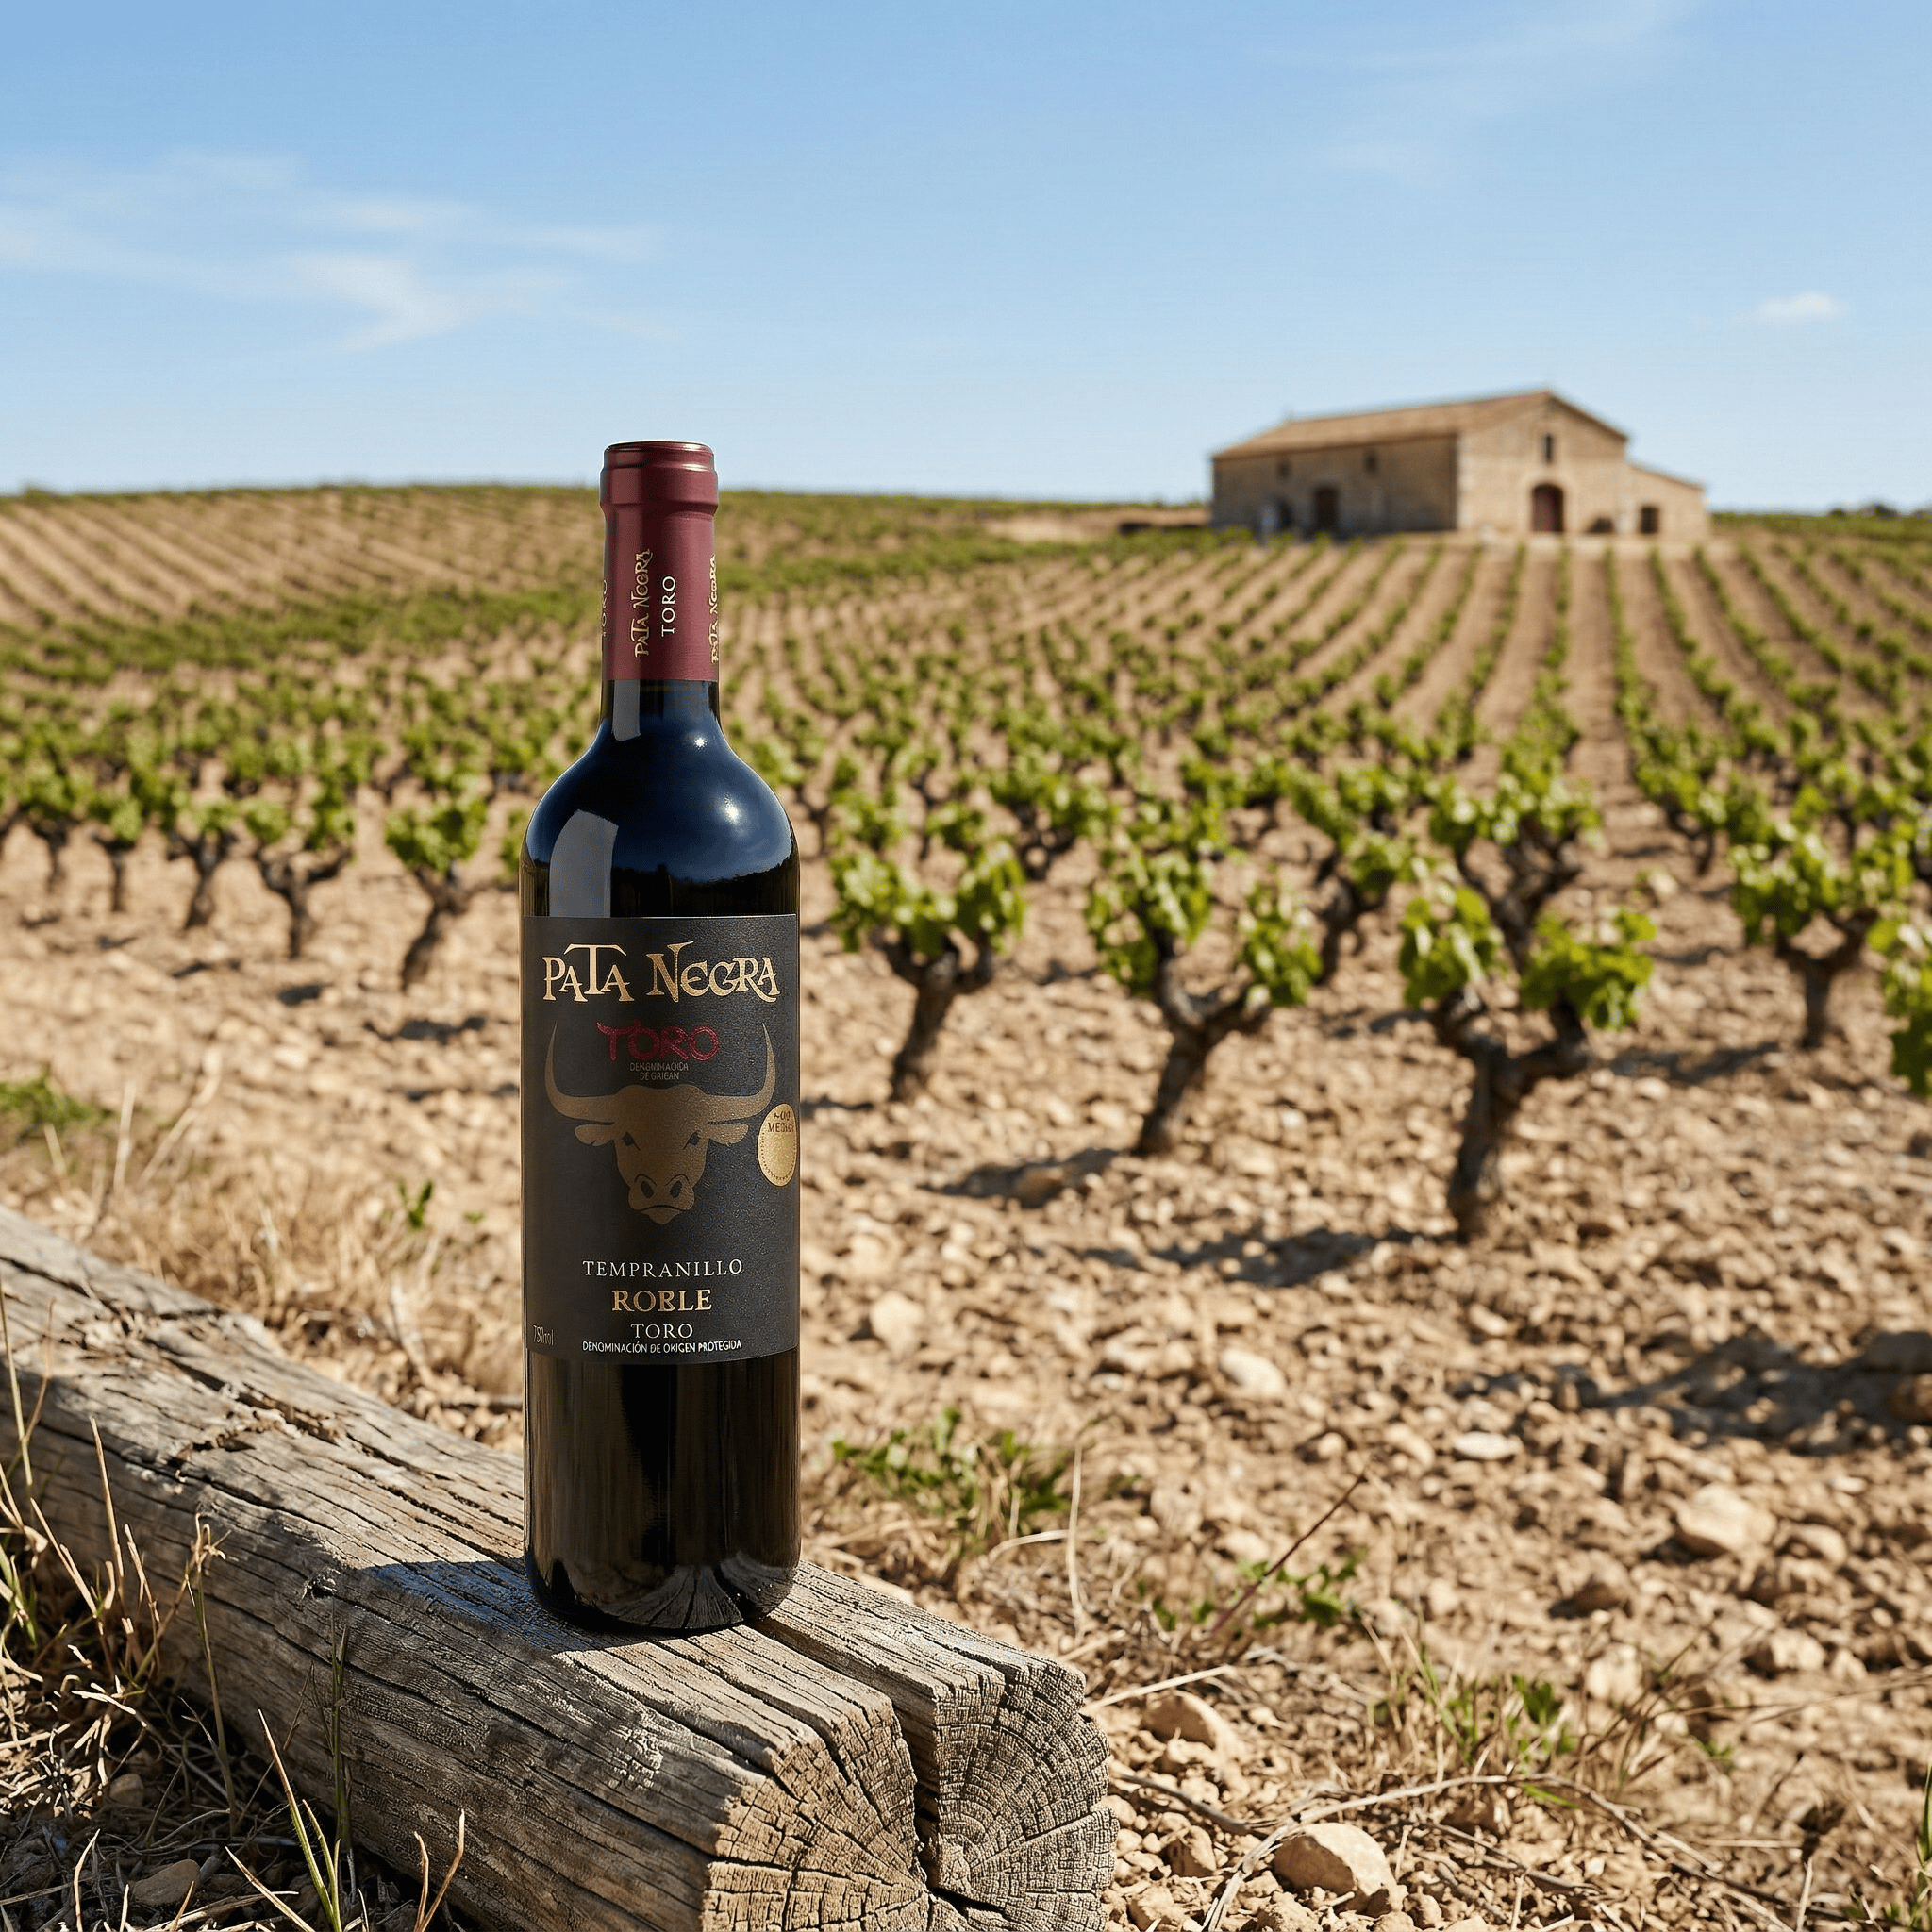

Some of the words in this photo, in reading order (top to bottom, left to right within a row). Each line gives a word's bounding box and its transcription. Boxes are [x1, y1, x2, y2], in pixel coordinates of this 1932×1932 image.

[630, 548, 653, 608] NEGRA
[661, 575, 676, 638] TORO
[630, 613, 651, 658] PATA
[541, 943, 635, 1002] PATA
[646, 941, 780, 1003] NEGRA
[596, 1019, 720, 1061] TORO
[583, 1259, 742, 1278] TEMPRANILLO
[611, 1289, 712, 1312] ROBLE
[582, 1341, 648, 1354] DENOMINACIÓN
[650, 1343, 661, 1354] DE
[698, 1340, 742, 1353] PROTEGIDA
[630, 1324, 693, 1339] TORO
